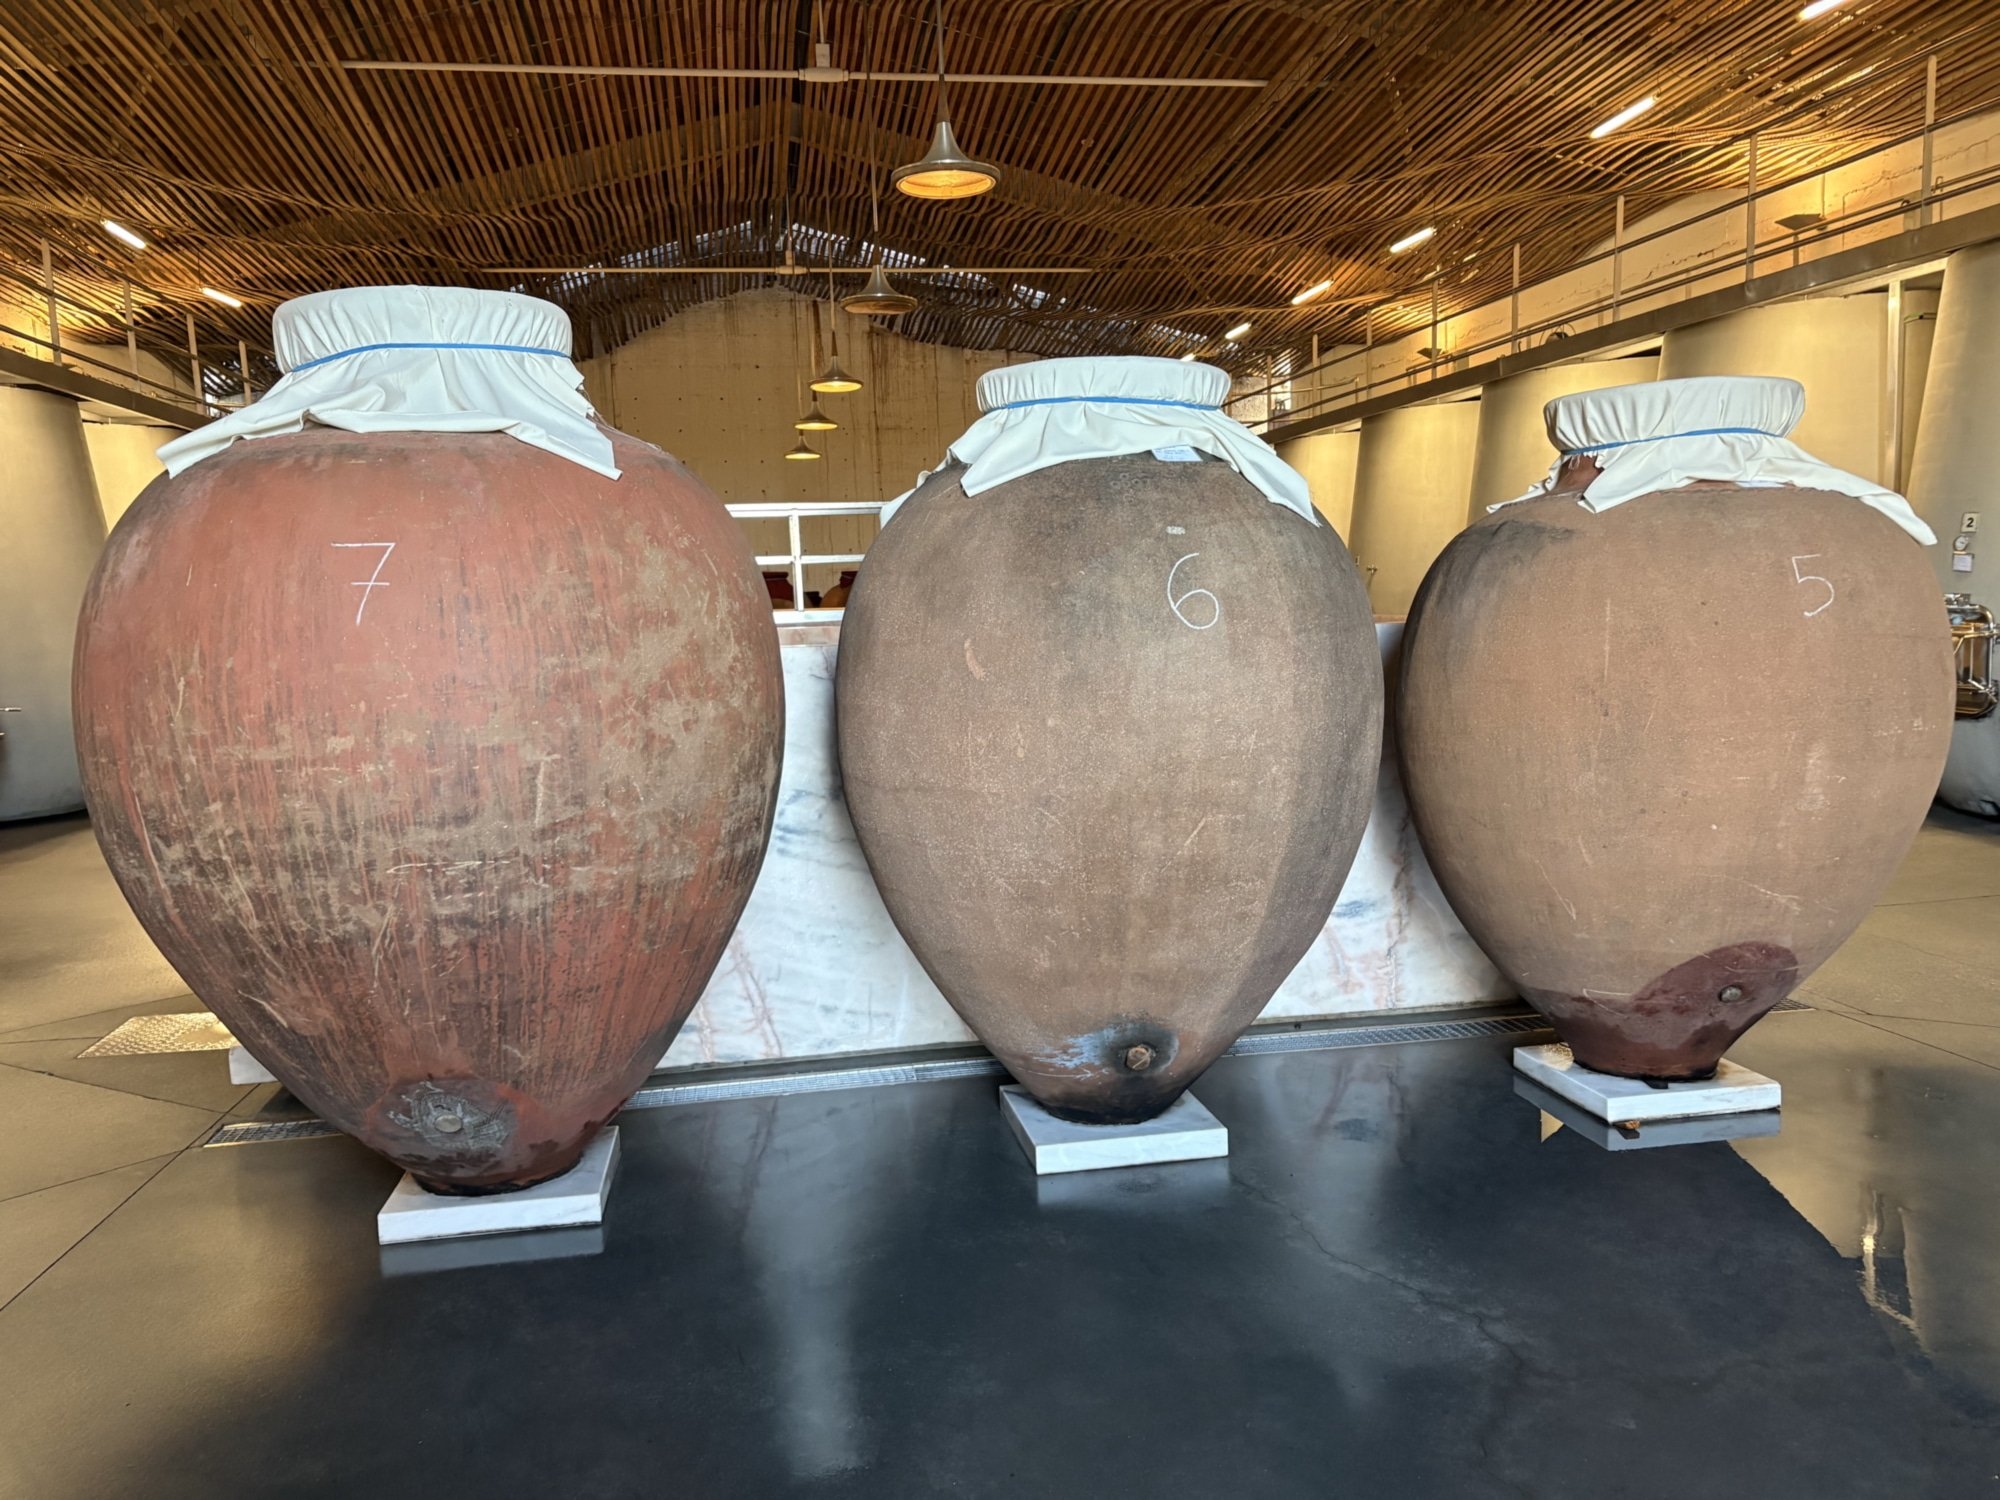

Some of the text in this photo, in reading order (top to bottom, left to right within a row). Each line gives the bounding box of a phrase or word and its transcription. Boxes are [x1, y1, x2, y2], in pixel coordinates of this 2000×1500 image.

[1966, 517, 1974, 528] 2
[331, 542, 396, 625] 7
[1167, 552, 1219, 630] 6
[1792, 554, 1835, 616] 5
